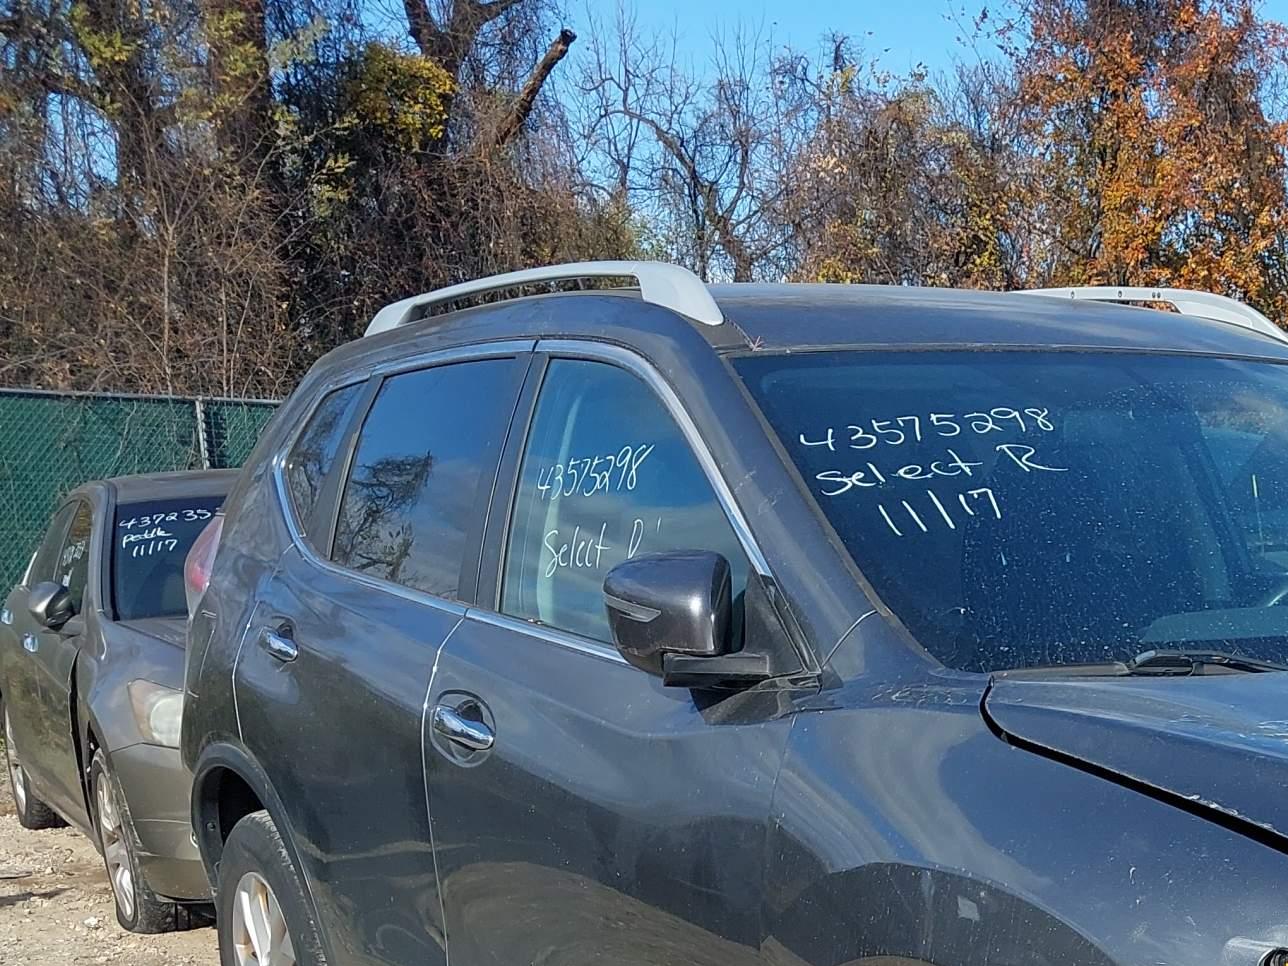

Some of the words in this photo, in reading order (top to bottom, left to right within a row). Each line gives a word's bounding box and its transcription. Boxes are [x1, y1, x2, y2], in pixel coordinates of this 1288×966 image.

[801, 407, 1054, 450] 43575298
[537, 444, 655, 500] 43575298
[815, 449, 983, 496] Select
[996, 443, 1069, 472] R
[878, 487, 1002, 536] 11/17
[132, 539, 178, 557] 11/17
[544, 522, 612, 578] Select
